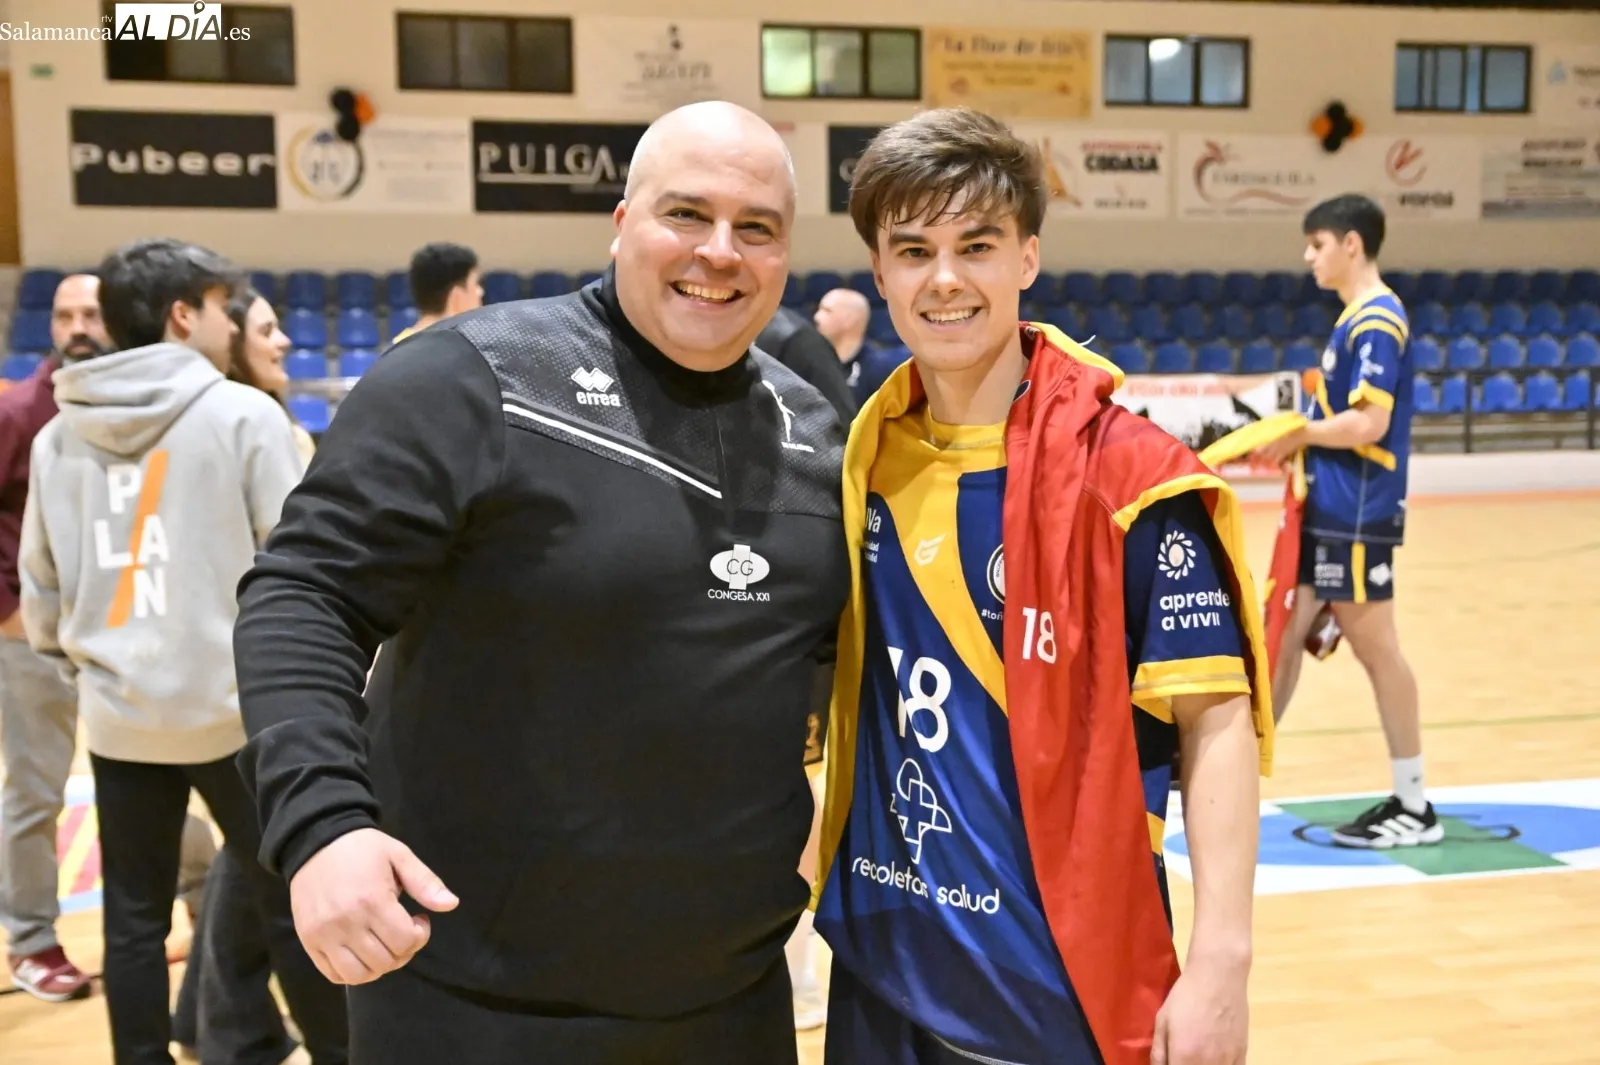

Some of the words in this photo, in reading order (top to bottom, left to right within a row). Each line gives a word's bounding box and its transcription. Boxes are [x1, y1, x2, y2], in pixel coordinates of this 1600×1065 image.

[72, 142, 275, 177] Pubeer
[576, 391, 622, 407] errea
[726, 558, 754, 576] CG
[707, 588, 755, 602] CONGESA
[755, 592, 771, 602] XXI
[1159, 587, 1231, 614] aprende
[1161, 615, 1176, 631] a
[1021, 606, 1057, 664] 18
[852, 856, 929, 899] recoletas
[936, 883, 1000, 914] salud
